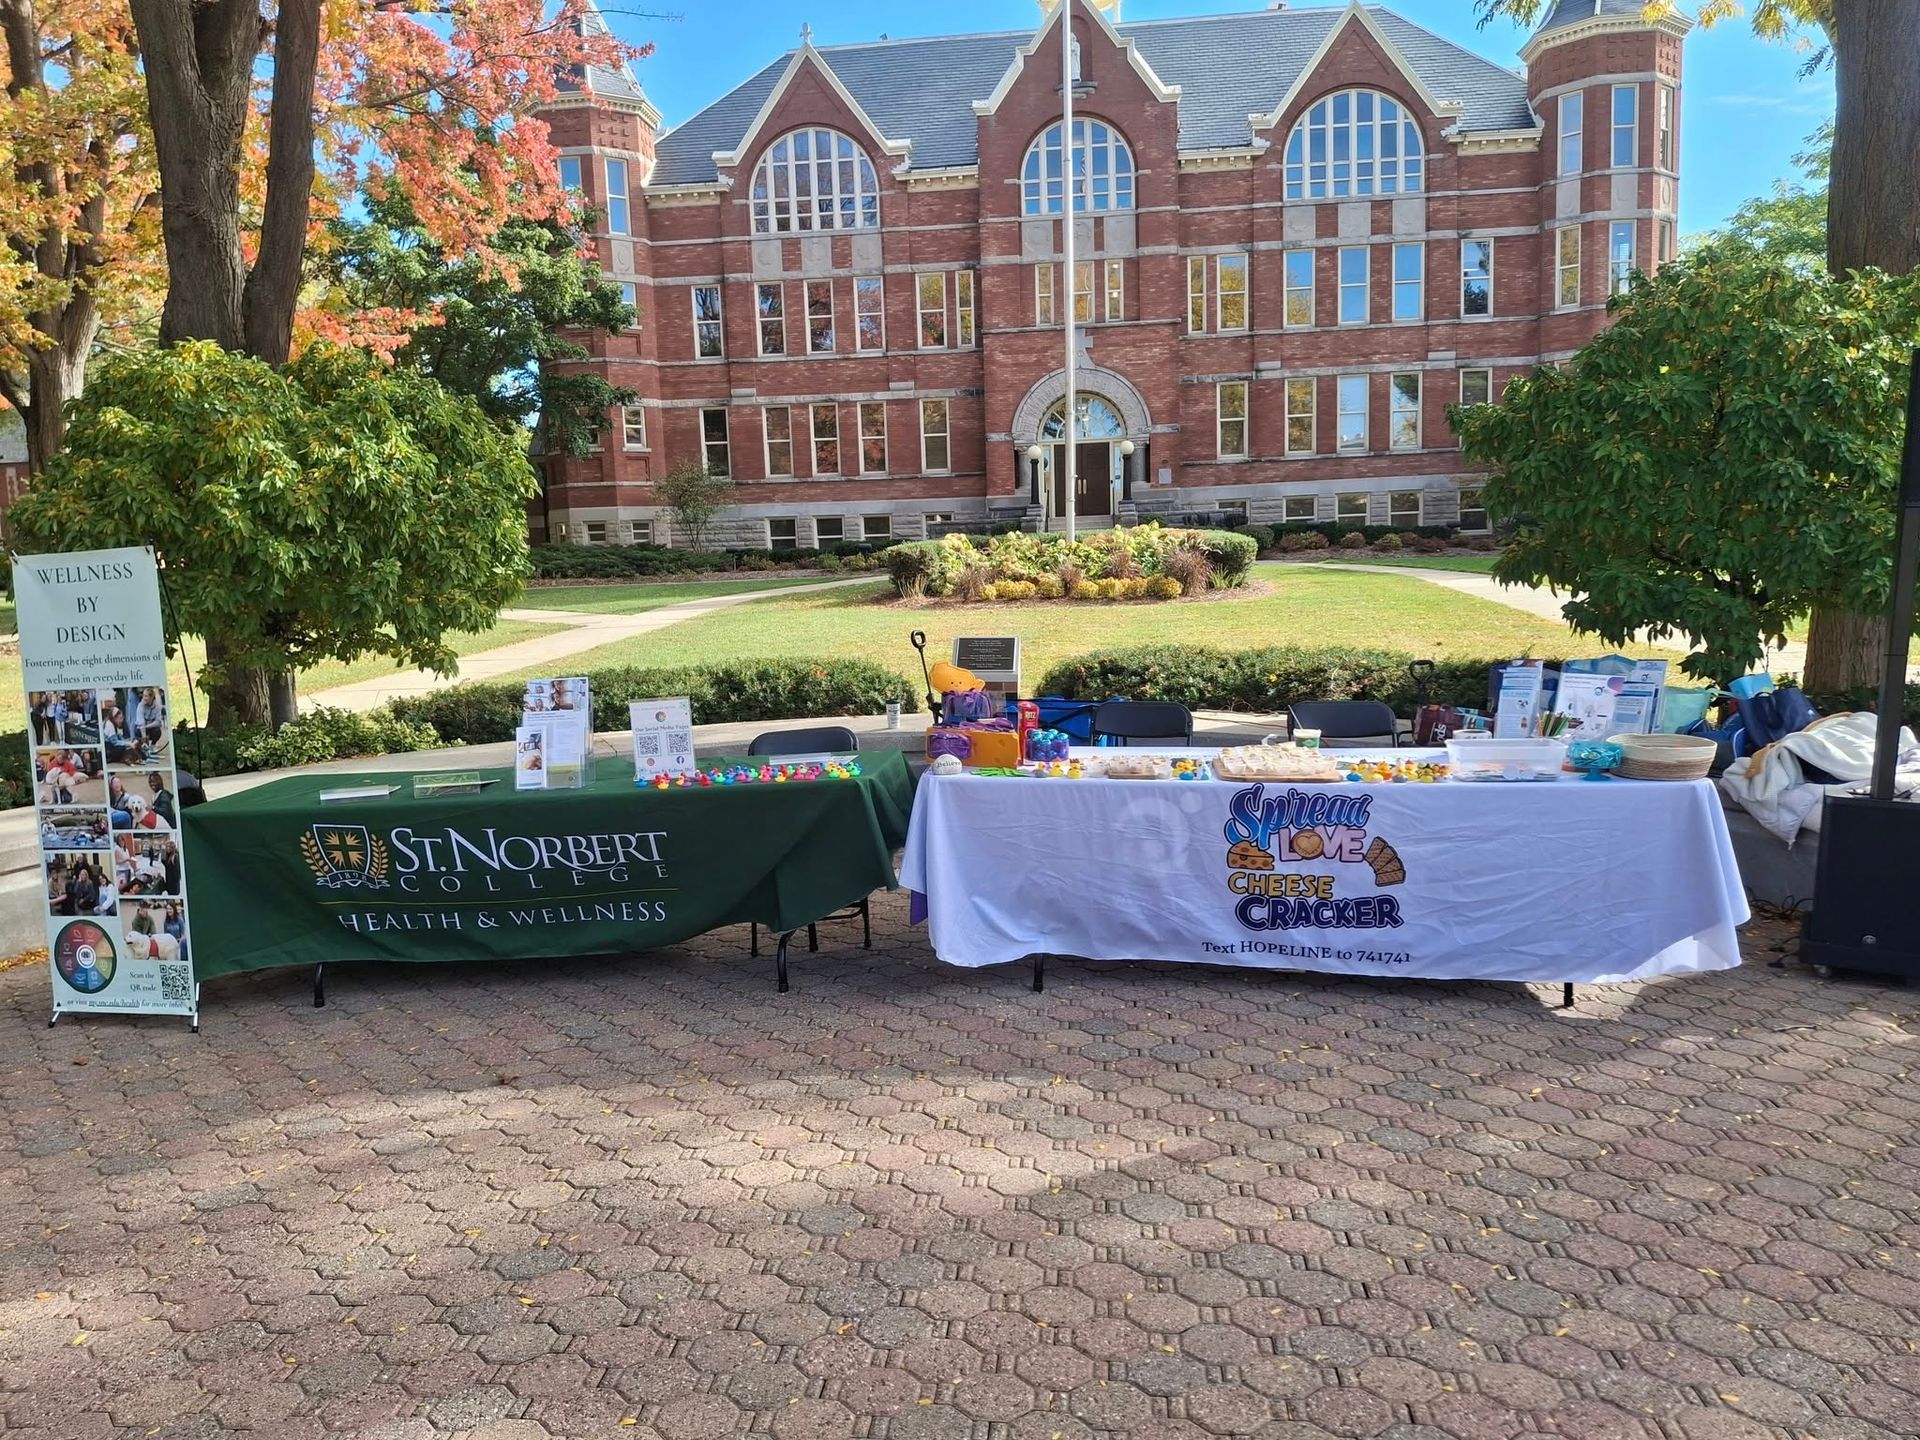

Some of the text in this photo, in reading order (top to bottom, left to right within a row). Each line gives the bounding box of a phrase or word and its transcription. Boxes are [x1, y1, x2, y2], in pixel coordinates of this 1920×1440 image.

[37, 562, 133, 585] WELLNESS
[77, 596, 99, 614] BY
[56, 623, 127, 644] DESIGN
[25, 651, 163, 669] Fostering the eight dimensions of
[46, 669, 143, 685] wellness in everyday life
[1224, 783, 1373, 850] Spread
[1278, 825, 1366, 863] LOVE
[400, 864, 670, 893] COLLEGE
[1228, 872, 1334, 899] CHEESE
[338, 901, 666, 933] HEALTH & WELLNESS
[1235, 895, 1404, 931] CRACKER
[1202, 940, 1411, 965] Text HOPELINE to 741741
[129, 970, 155, 979] Scan the
[130, 984, 141, 992] QR
[141, 999, 151, 1008] for
